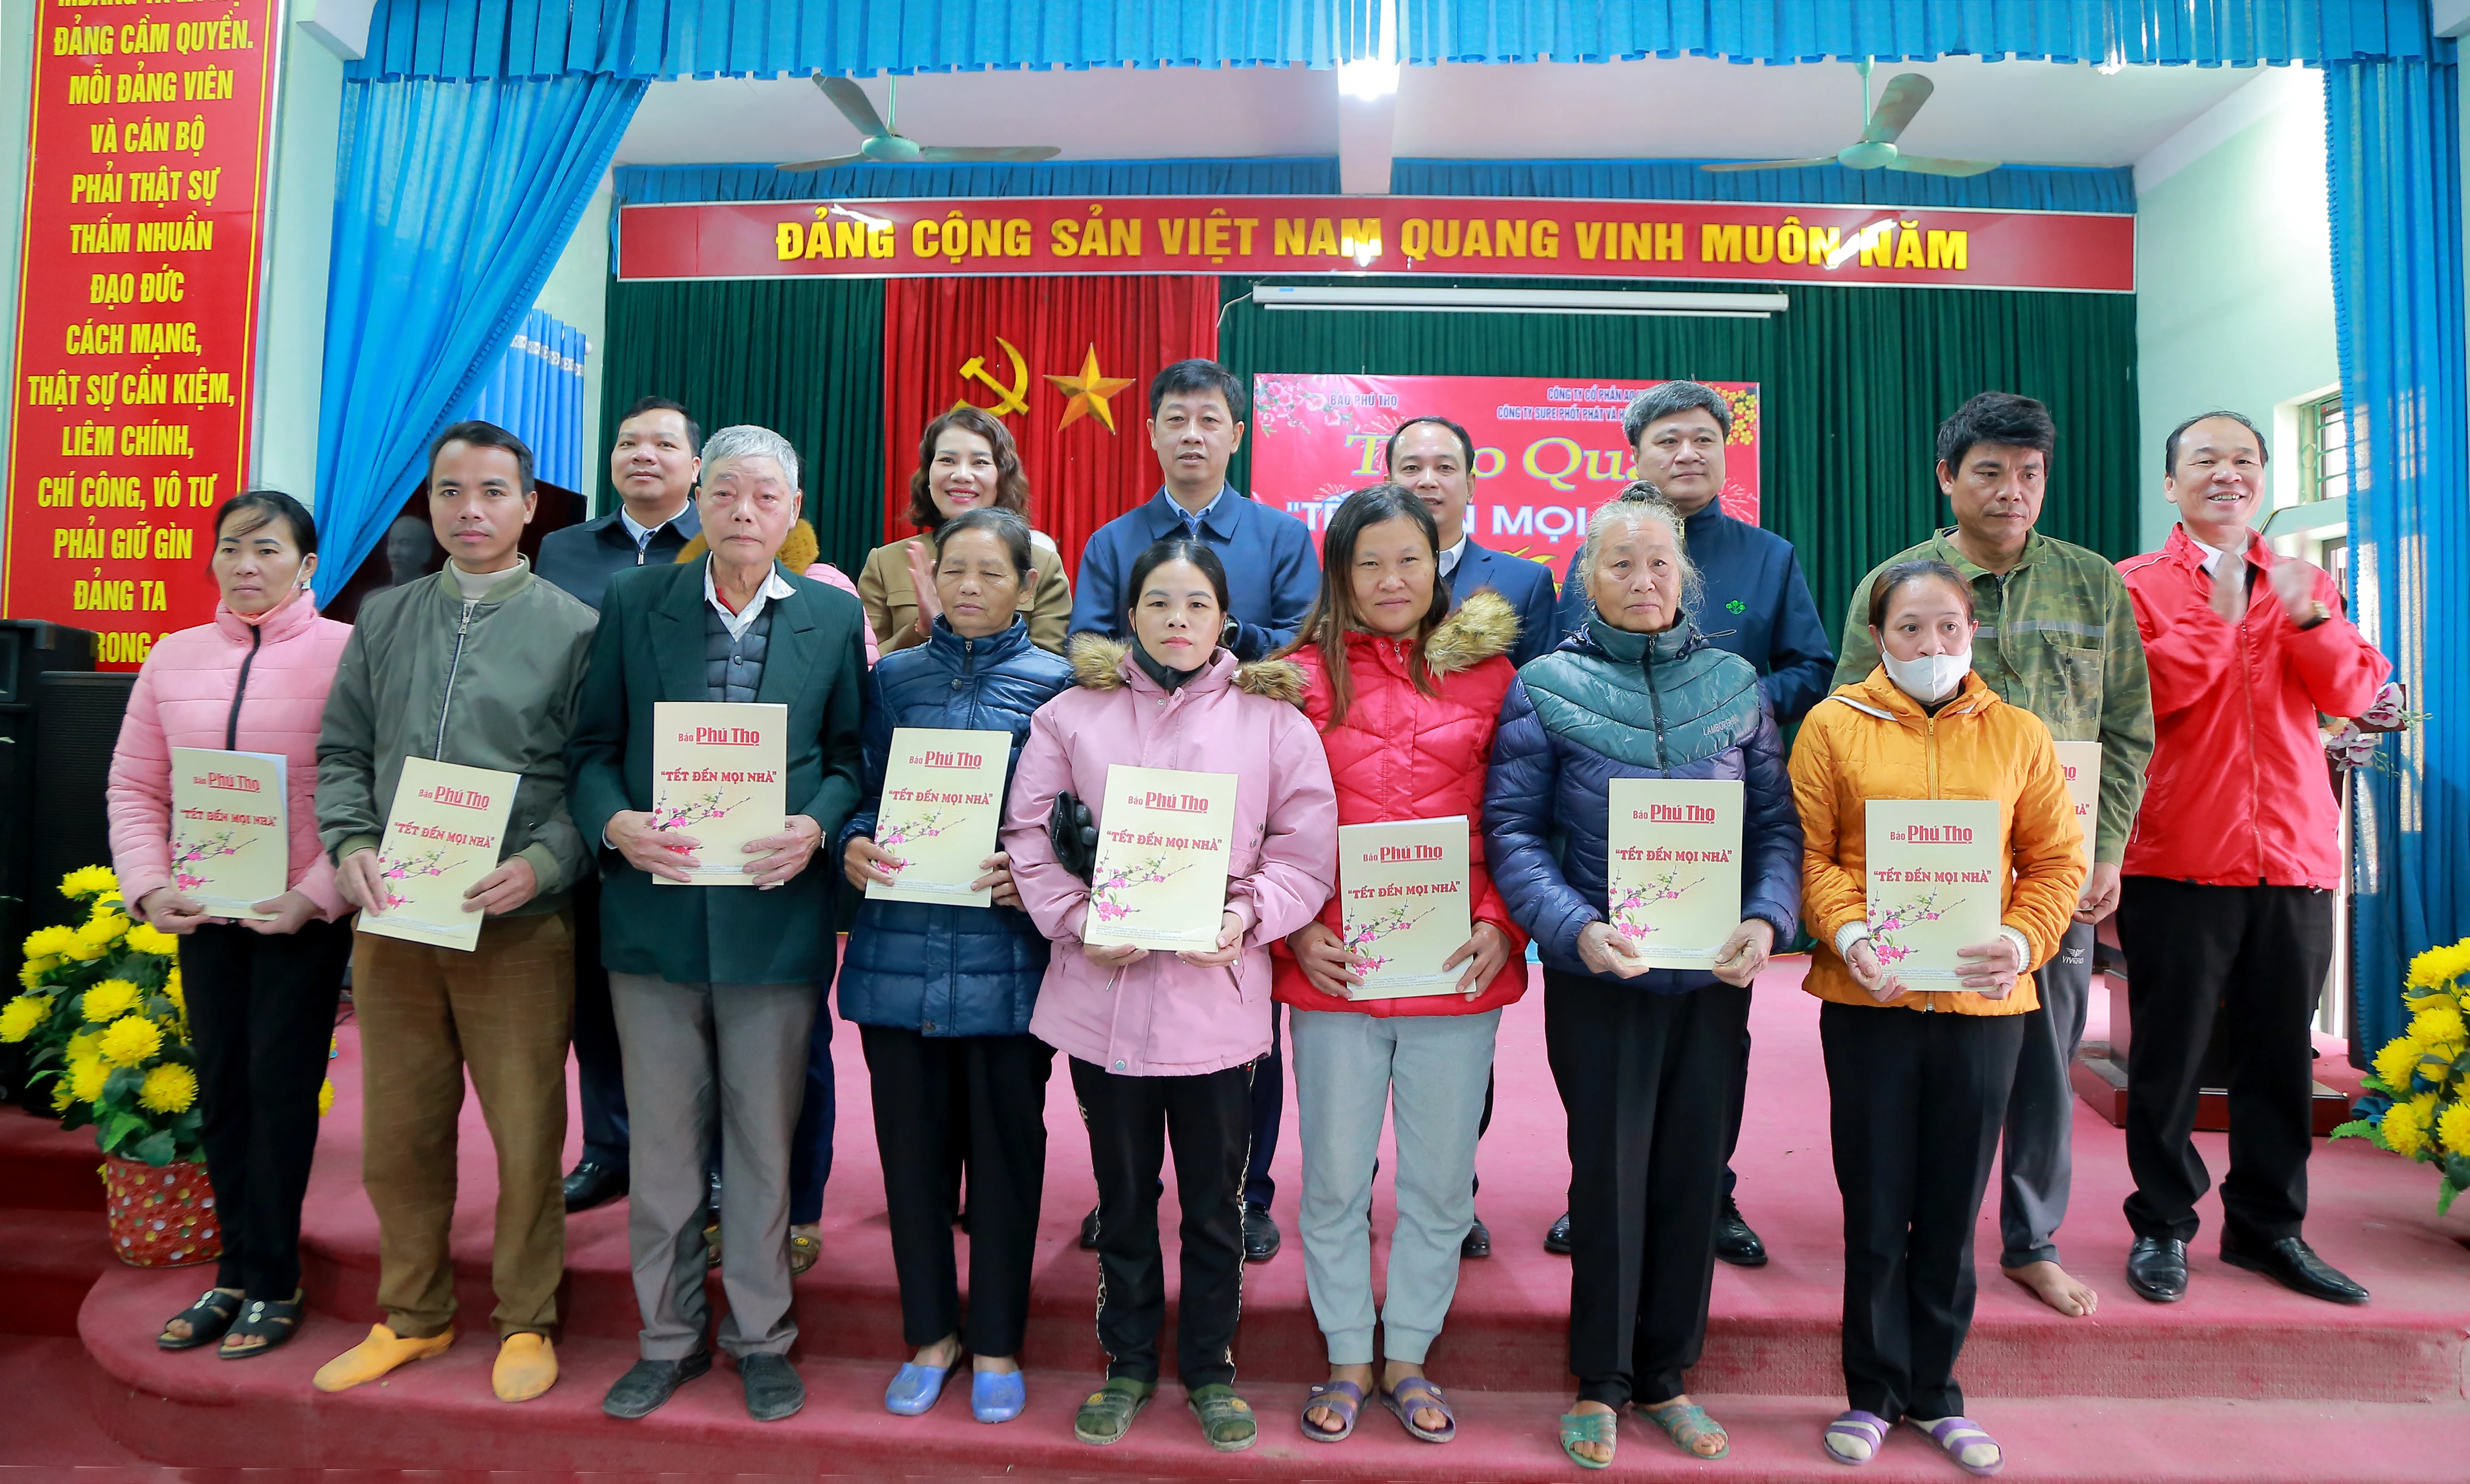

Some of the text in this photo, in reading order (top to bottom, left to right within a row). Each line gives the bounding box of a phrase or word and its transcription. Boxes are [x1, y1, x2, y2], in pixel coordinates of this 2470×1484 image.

[54, 10, 254, 56] ĐẢNG CẦM QUYỀN.
[69, 60, 234, 105] MỖI ĐẢNG VIÊN
[90, 114, 205, 156] VÀ CÁN BỘ
[70, 160, 221, 208] PHẢI THẬT SỰ
[70, 210, 213, 253] THẤM NHUẦN
[776, 203, 1968, 270] ĐẢNG CỘNG SẢN VIỆT NAM QUANG VINH MUÔN NĂM
[90, 264, 185, 310] ĐẠO ĐỨC
[65, 318, 202, 360] CÁCH MẠNG,
[28, 364, 235, 412] THẬT SỰ CẦN KIỆM,
[1330, 392, 1398, 409] BÁO PHÚ THỌ
[1547, 385, 1571, 400] CÔNG
[1573, 387, 1582, 400] TY
[1497, 404, 1521, 418] CÔNG
[1523, 406, 1532, 418] TY
[1535, 406, 1558, 419] SUPE
[1558, 404, 1580, 419] PHỐT
[1582, 405, 1605, 420] PHÁT
[1605, 405, 1618, 420] VÀ
[62, 419, 194, 459] LIÊM CHÍNH,
[38, 470, 218, 511] CHÍ CÔNG, VÔ TƯ
[1492, 504, 1587, 543] MỌI
[53, 515, 193, 560] PHẢI GIỮ GÌN
[73, 566, 167, 610] ĐẢNG TA
[97, 632, 151, 663] RONG
[678, 727, 760, 746] Báo Phú Thọ
[909, 750, 982, 769] Báo Phú Thọ
[660, 768, 777, 784] “TẾT ĐẾN MỌI NHÀ”
[419, 785, 490, 811] Báo Phú Thọ
[888, 788, 993, 805] “TẾT ĐẾN MỌI NHÀ”
[1128, 791, 1209, 814] Báo Phú Thọ
[1633, 804, 1715, 824] Báo Phú Thọ
[394, 821, 495, 848] “TẾT ĐẾN MỌI NHÀ”
[1106, 829, 1222, 851] “TẾT ĐẾN MỌI NHÀ”
[1890, 825, 1973, 844] Báo Phú Thọ
[1363, 844, 1443, 862] Báo Phú Thọ
[1615, 846, 1732, 864] “TẾT ĐẾN MỌI NHÀ”
[1874, 867, 1991, 885] “TẾT ĐẾN MỌI NHÀ”
[1348, 880, 1460, 899] “TẾT ĐẾN MỌI NHÀ”
[2062, 955, 2084, 964] VIVERO
